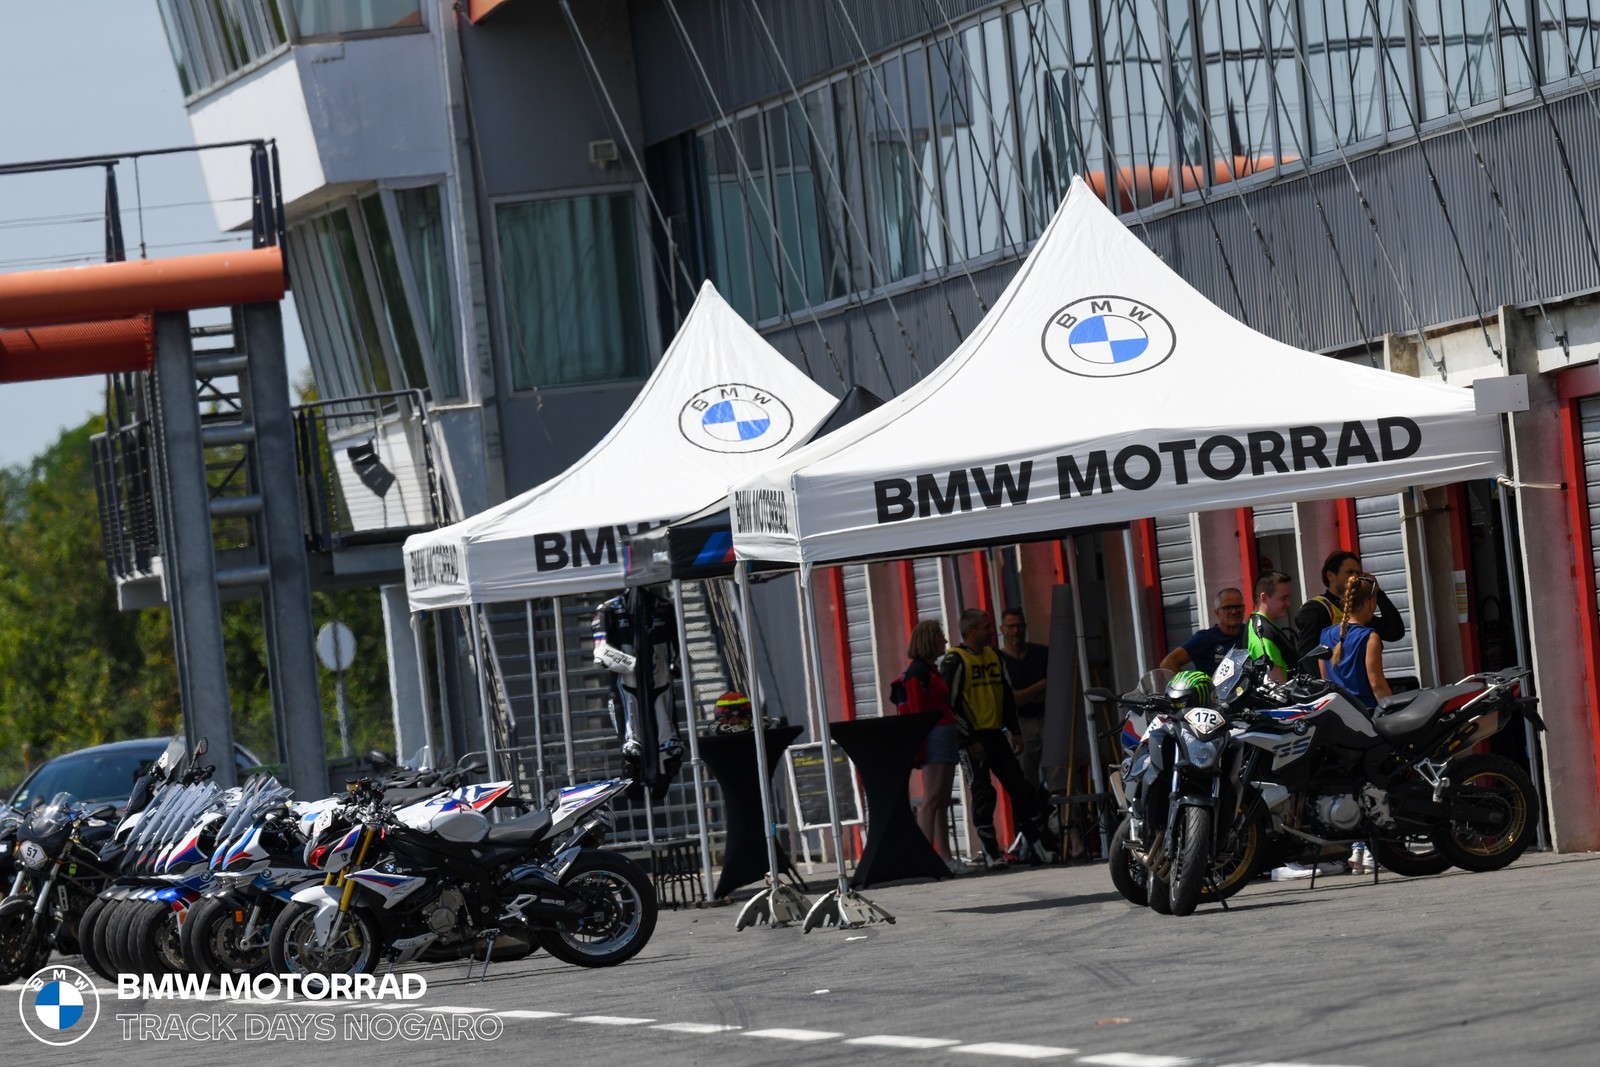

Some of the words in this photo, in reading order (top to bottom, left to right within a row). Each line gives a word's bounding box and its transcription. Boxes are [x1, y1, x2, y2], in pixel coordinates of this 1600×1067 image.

[1056, 300, 1152, 330] BMW
[691, 387, 771, 411] BMW
[873, 460, 1033, 524] BMW
[1056, 416, 1422, 500] MOTORRAD
[1194, 711, 1217, 725] 172
[26, 846, 38, 859] 57
